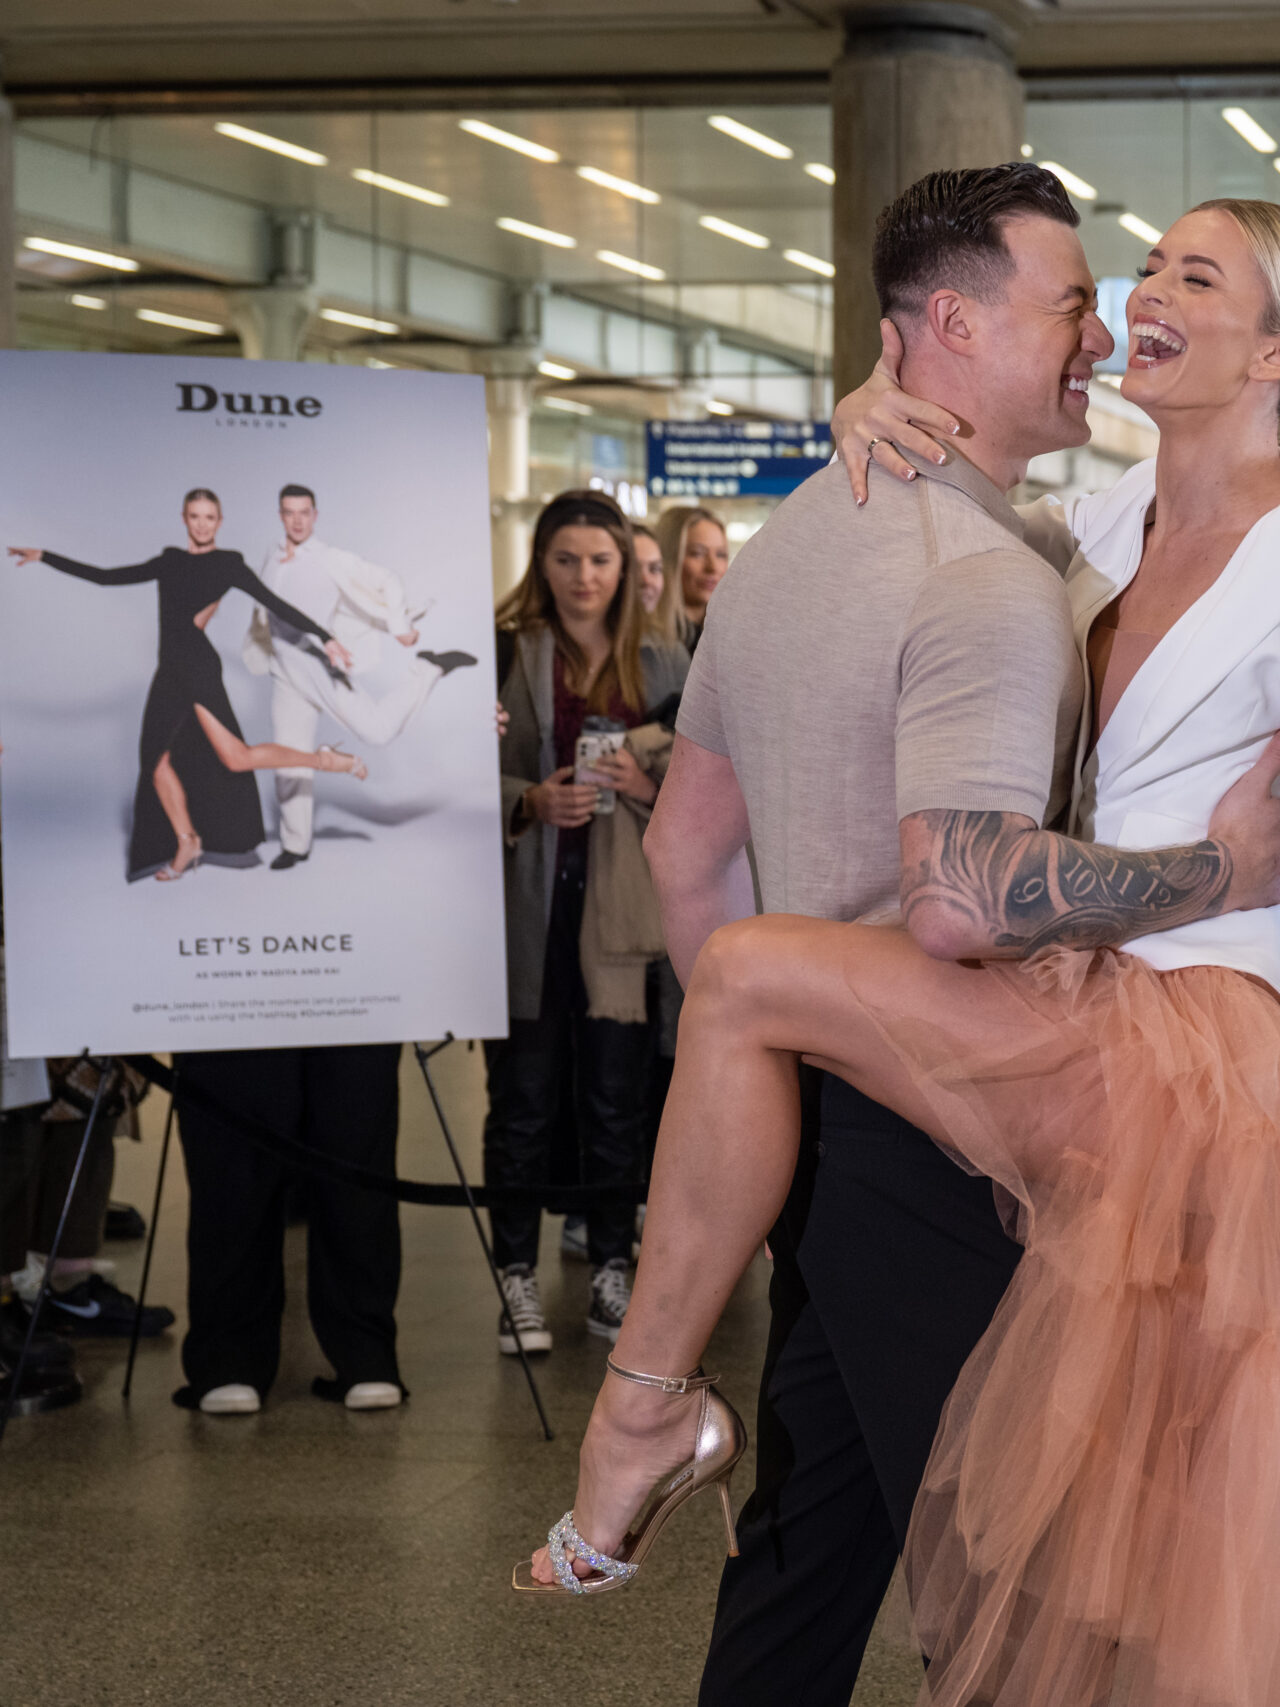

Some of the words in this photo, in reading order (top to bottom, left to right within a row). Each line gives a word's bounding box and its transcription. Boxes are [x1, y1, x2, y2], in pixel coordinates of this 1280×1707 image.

[175, 382, 323, 418] Dune
[215, 417, 288, 429] LONDON
[1013, 876, 1045, 904] 9
[1063, 856, 1098, 898] 10
[1105, 858, 1136, 897] 11
[262, 934, 353, 954] DANCE
[195, 970, 208, 979] AS
[211, 969, 242, 979] WORN
[245, 968, 258, 978] BY
[261, 967, 298, 977] NADIYA
[300, 967, 321, 976] AND
[217, 998, 246, 1009] Share
[248, 998, 266, 1008] the
